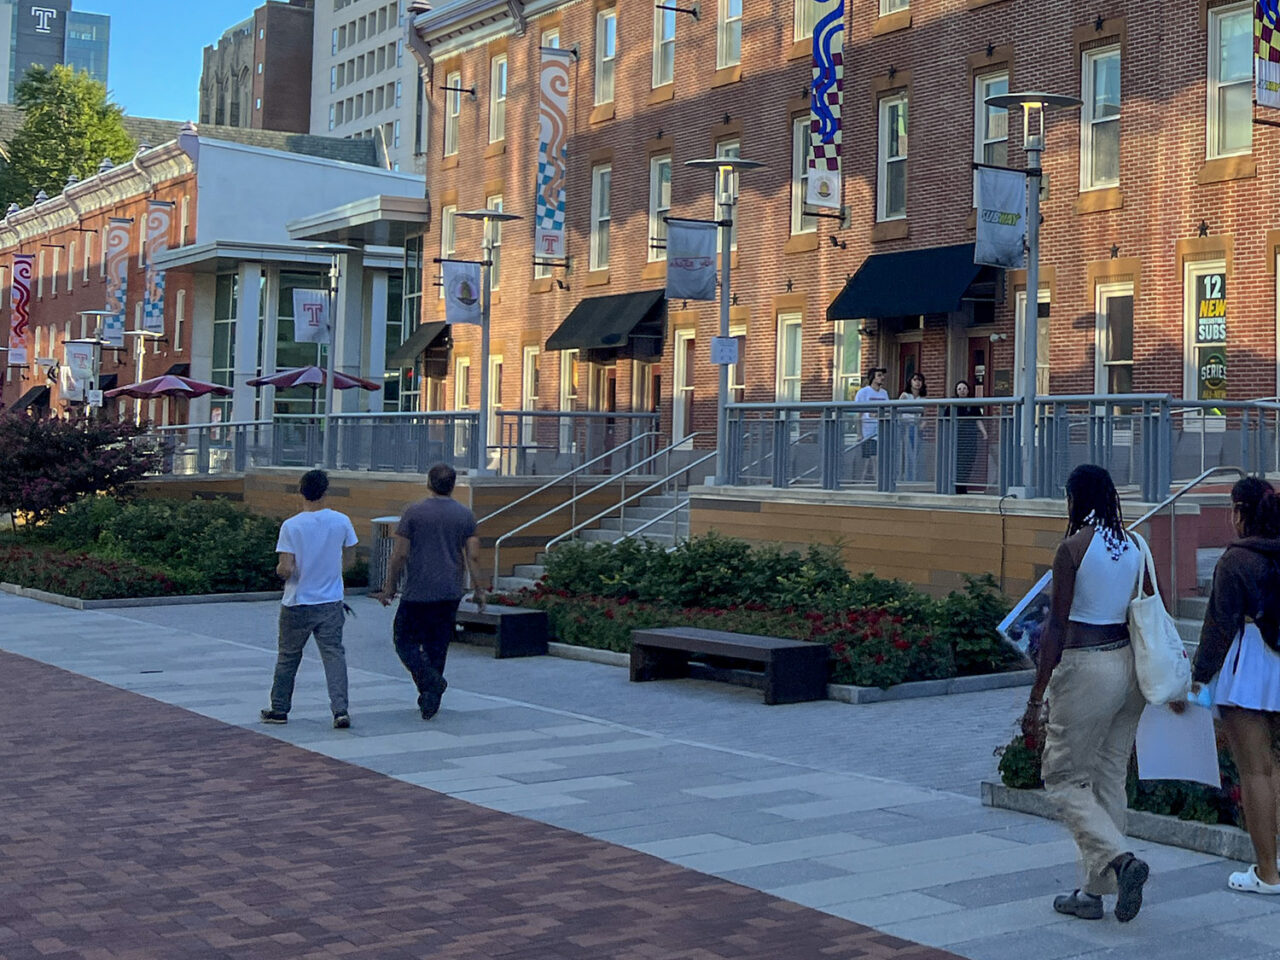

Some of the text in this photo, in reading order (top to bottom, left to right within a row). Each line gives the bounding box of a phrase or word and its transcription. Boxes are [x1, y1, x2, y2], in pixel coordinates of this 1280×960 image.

[32, 6, 57, 33] T
[982, 209, 1021, 226] SUBWAY
[542, 235, 559, 254] T
[1204, 275, 1221, 299] 12
[303, 303, 323, 327] T
[1200, 299, 1226, 317] NEW
[1199, 324, 1226, 340] SUBS
[1201, 364, 1227, 380] SERIES
